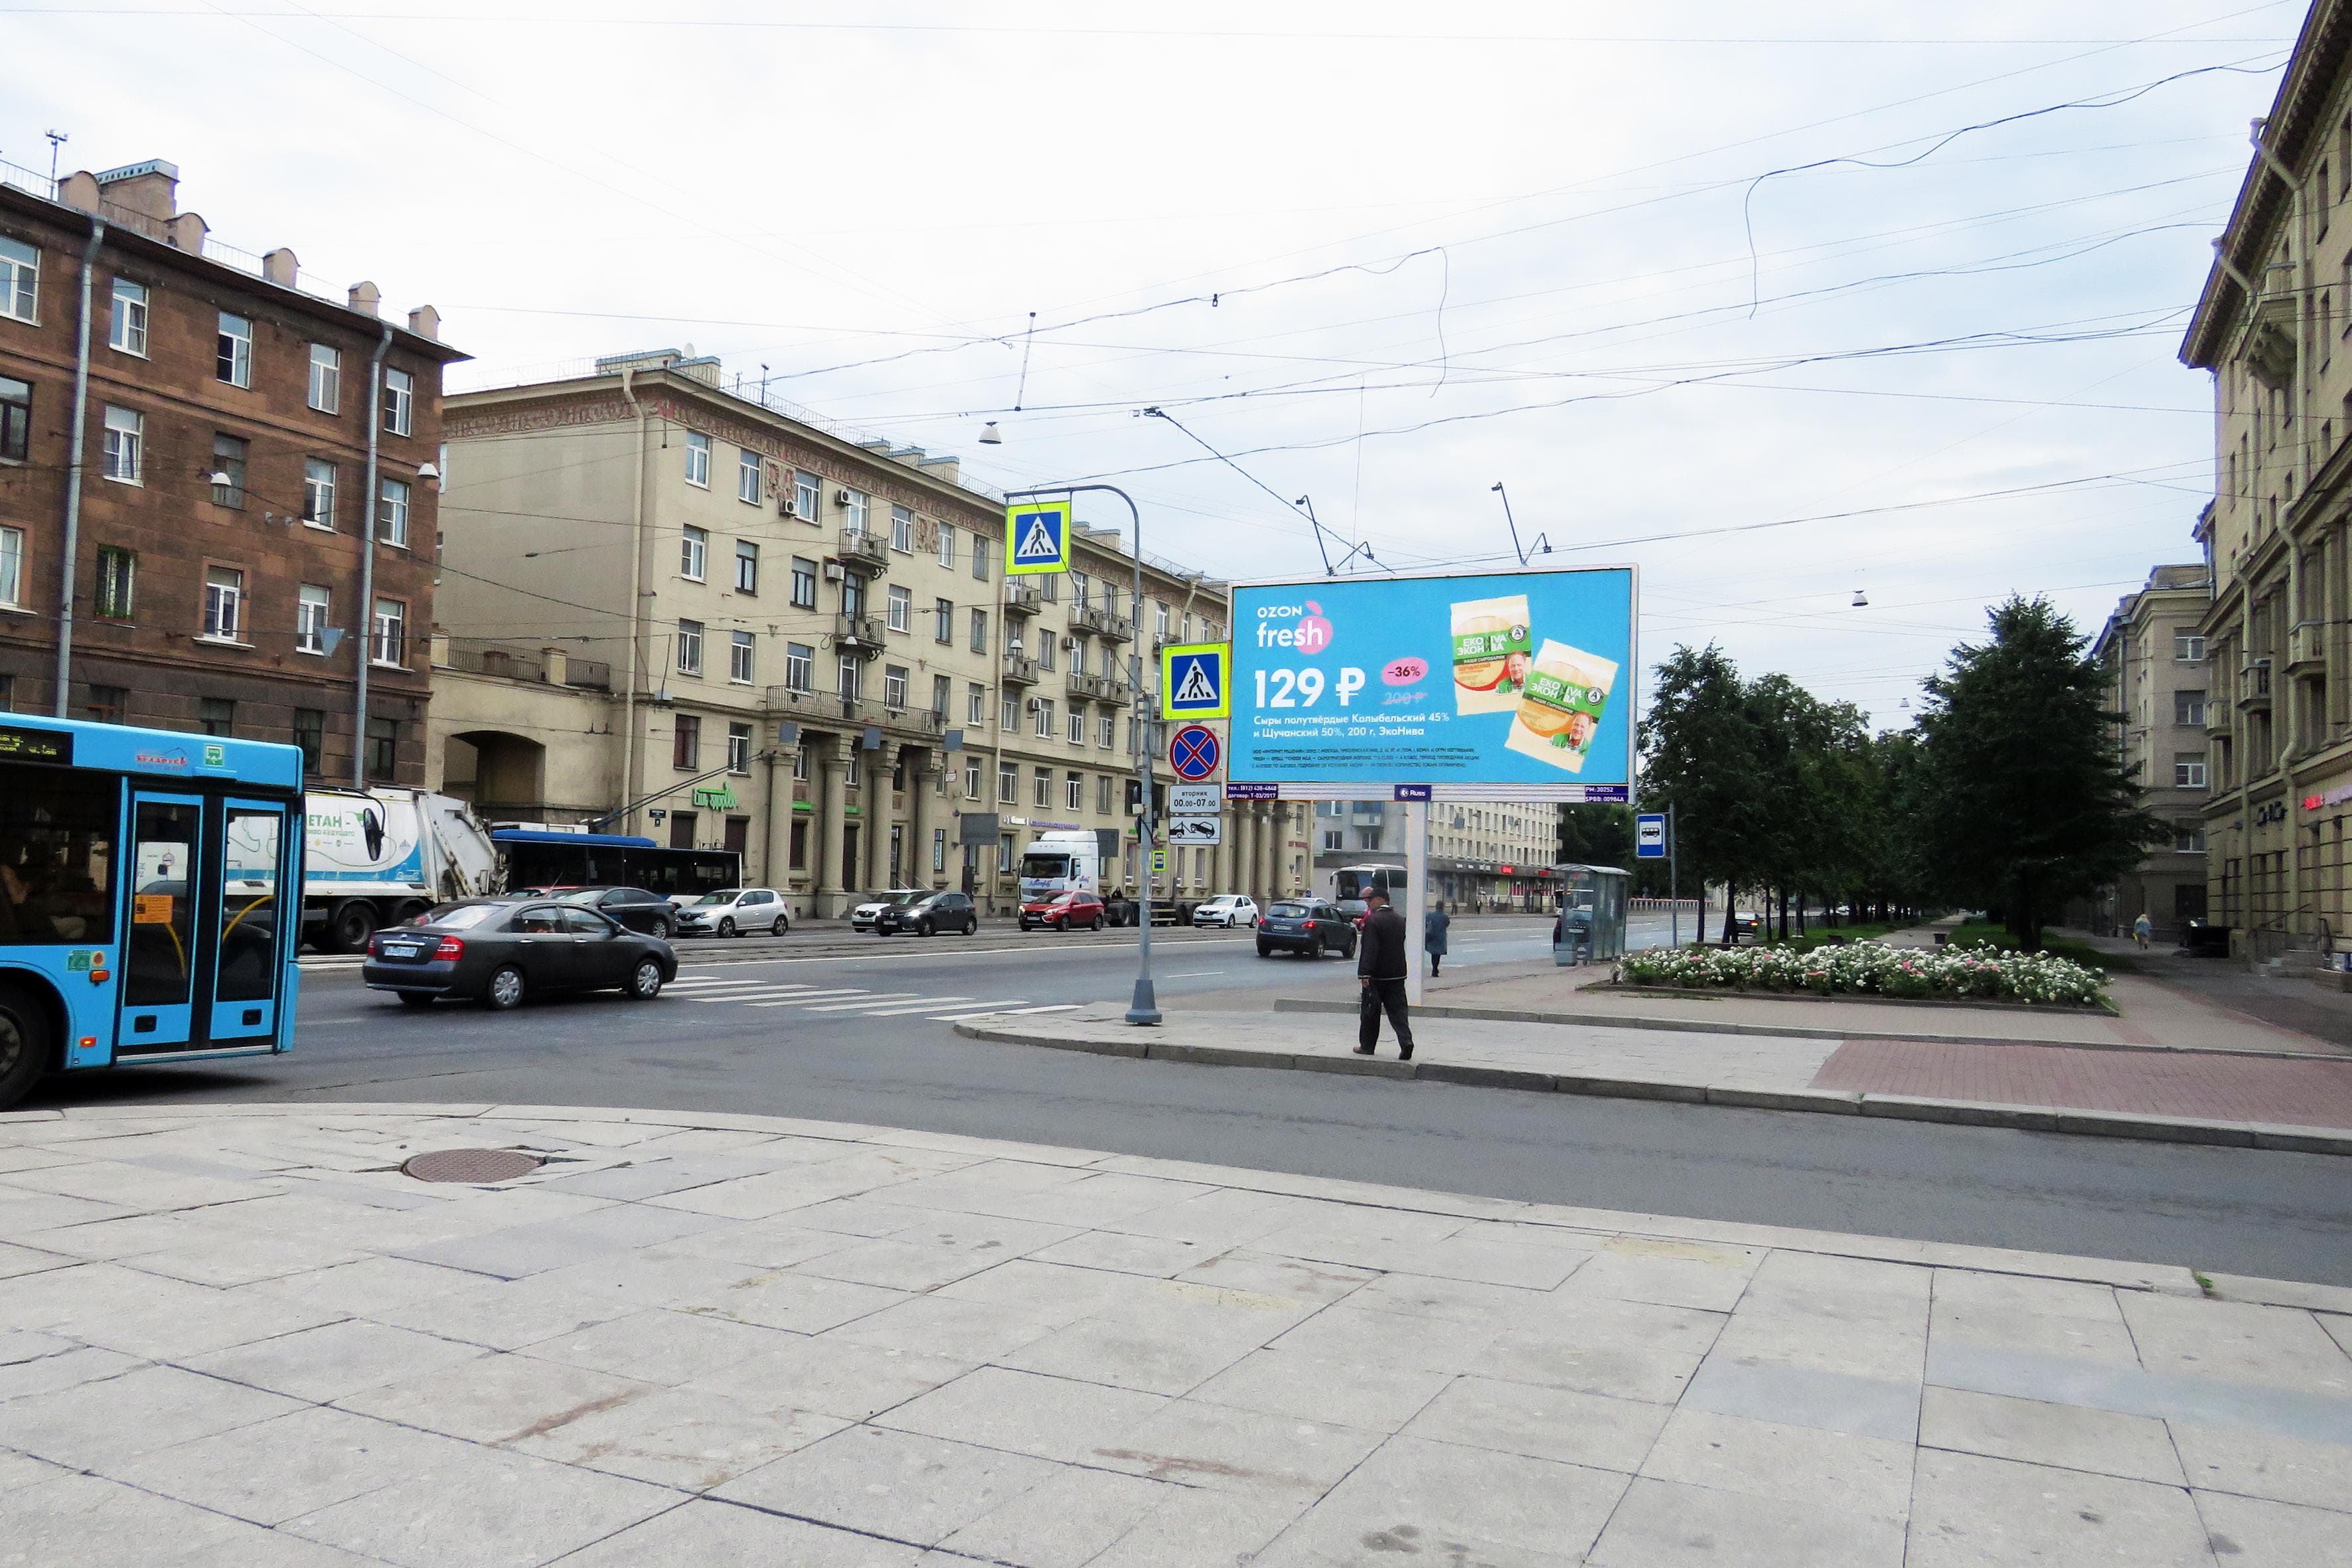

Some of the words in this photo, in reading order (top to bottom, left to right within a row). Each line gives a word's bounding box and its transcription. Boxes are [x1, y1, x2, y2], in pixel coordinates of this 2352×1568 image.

[1257, 605, 1302, 618] OZON
[1257, 619, 1324, 648] fresh
[1255, 667, 1325, 708] 129
[1335, 666, 1366, 706] ₽
[1253, 716, 1282, 726] Сыры
[1285, 715, 1349, 726] полутвёрдые
[1352, 712, 1426, 723] Колыбельский
[1428, 712, 1450, 722] 45%
[1262, 728, 1318, 739] Щучанский
[1321, 727, 1345, 738] 50%,
[1348, 726, 1367, 736] 200
[1379, 726, 1425, 736] ЭкоНива
[307, 814, 342, 828] ЕТАН
